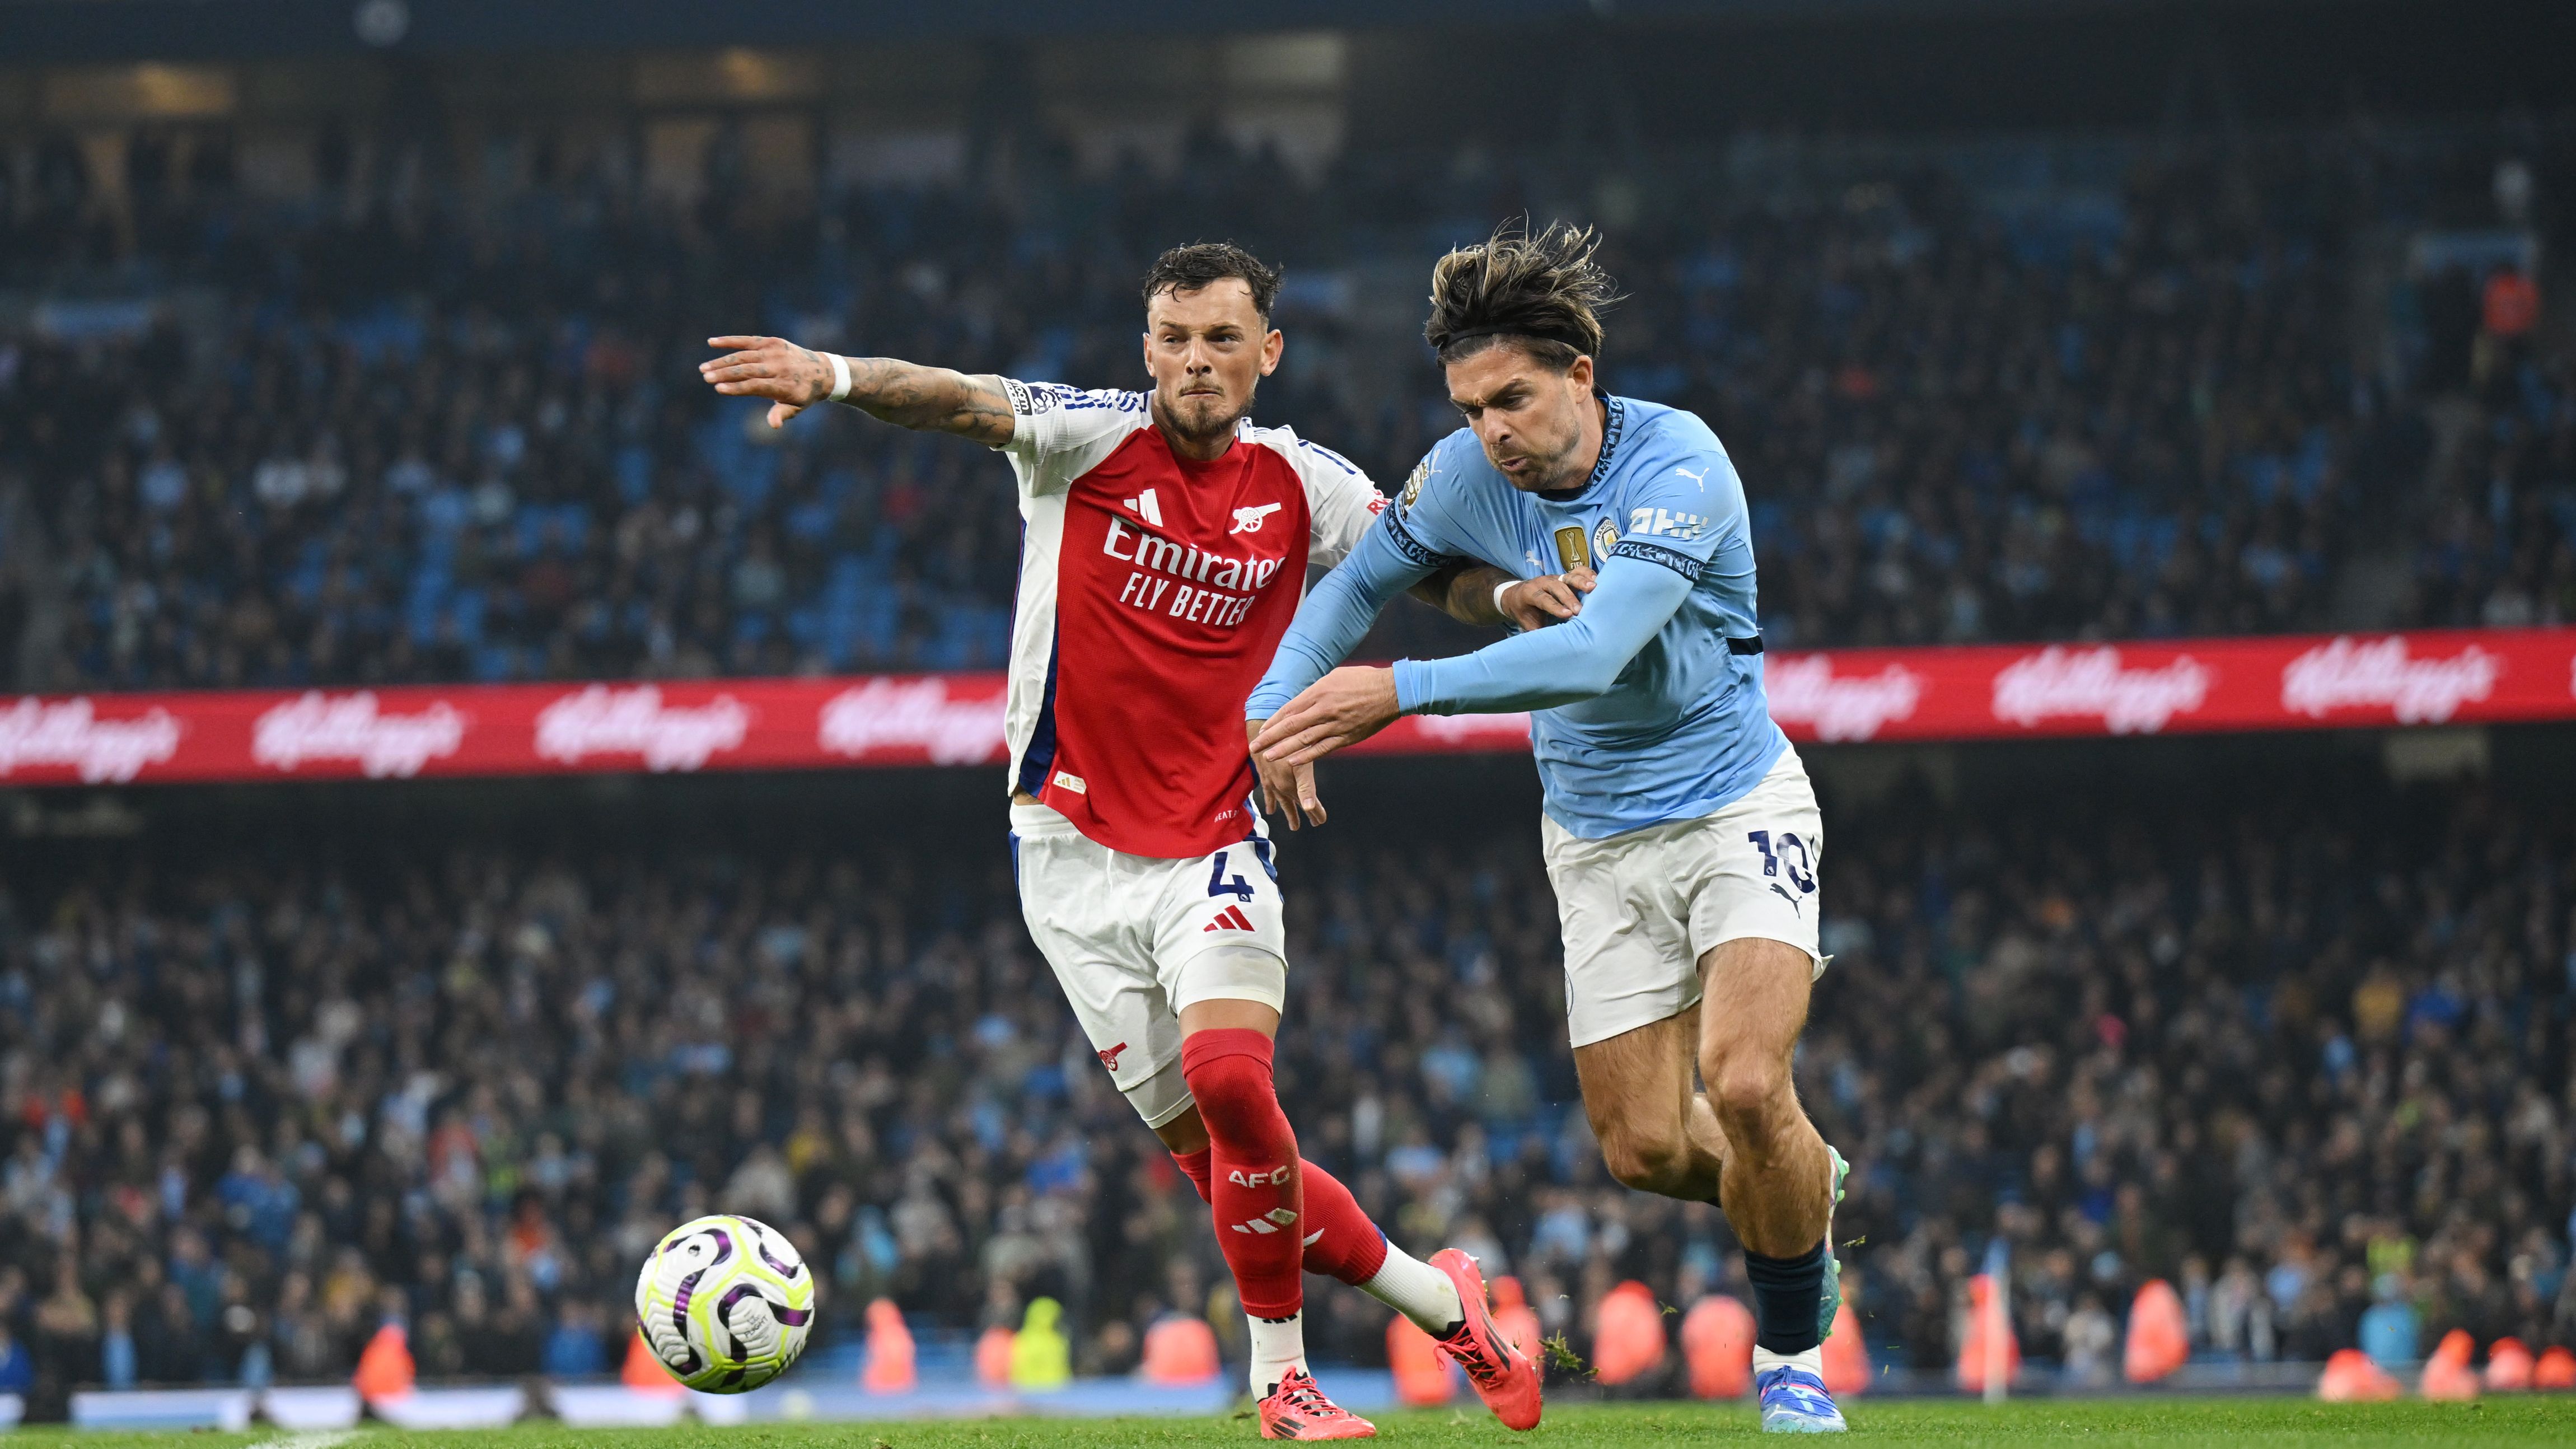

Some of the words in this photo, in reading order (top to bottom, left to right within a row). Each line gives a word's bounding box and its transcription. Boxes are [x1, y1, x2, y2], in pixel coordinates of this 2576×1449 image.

[1120, 572, 1170, 610] FLY
[1169, 585, 1255, 626] BETTER
[818, 677, 1007, 764] Kellogg
[1765, 654, 1920, 742] ellogg's
[1208, 852, 1254, 903] 4
[1748, 830, 1816, 893] 10
[1229, 1165, 1291, 1188] AFC
